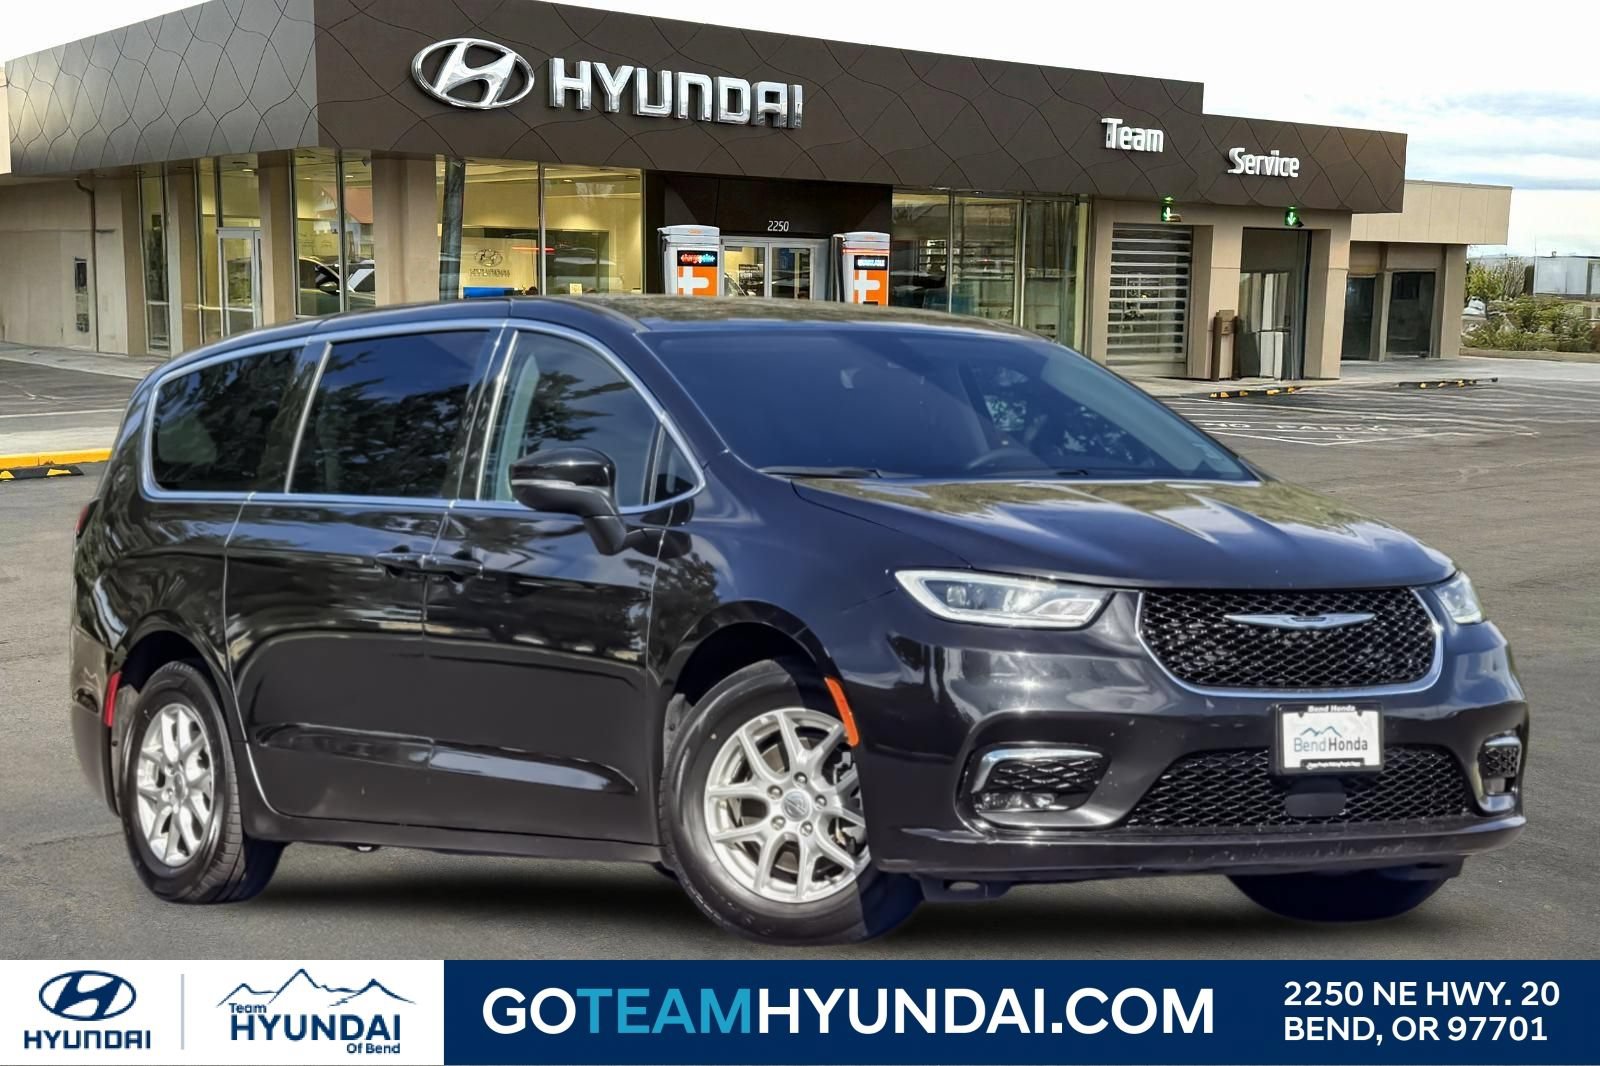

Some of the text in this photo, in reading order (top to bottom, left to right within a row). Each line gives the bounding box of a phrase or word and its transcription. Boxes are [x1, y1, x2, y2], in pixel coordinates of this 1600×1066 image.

[549, 57, 803, 129] HYUNDAI
[1101, 117, 1164, 152] Team
[1228, 147, 1300, 177] Service
[767, 220, 790, 232] 2250
